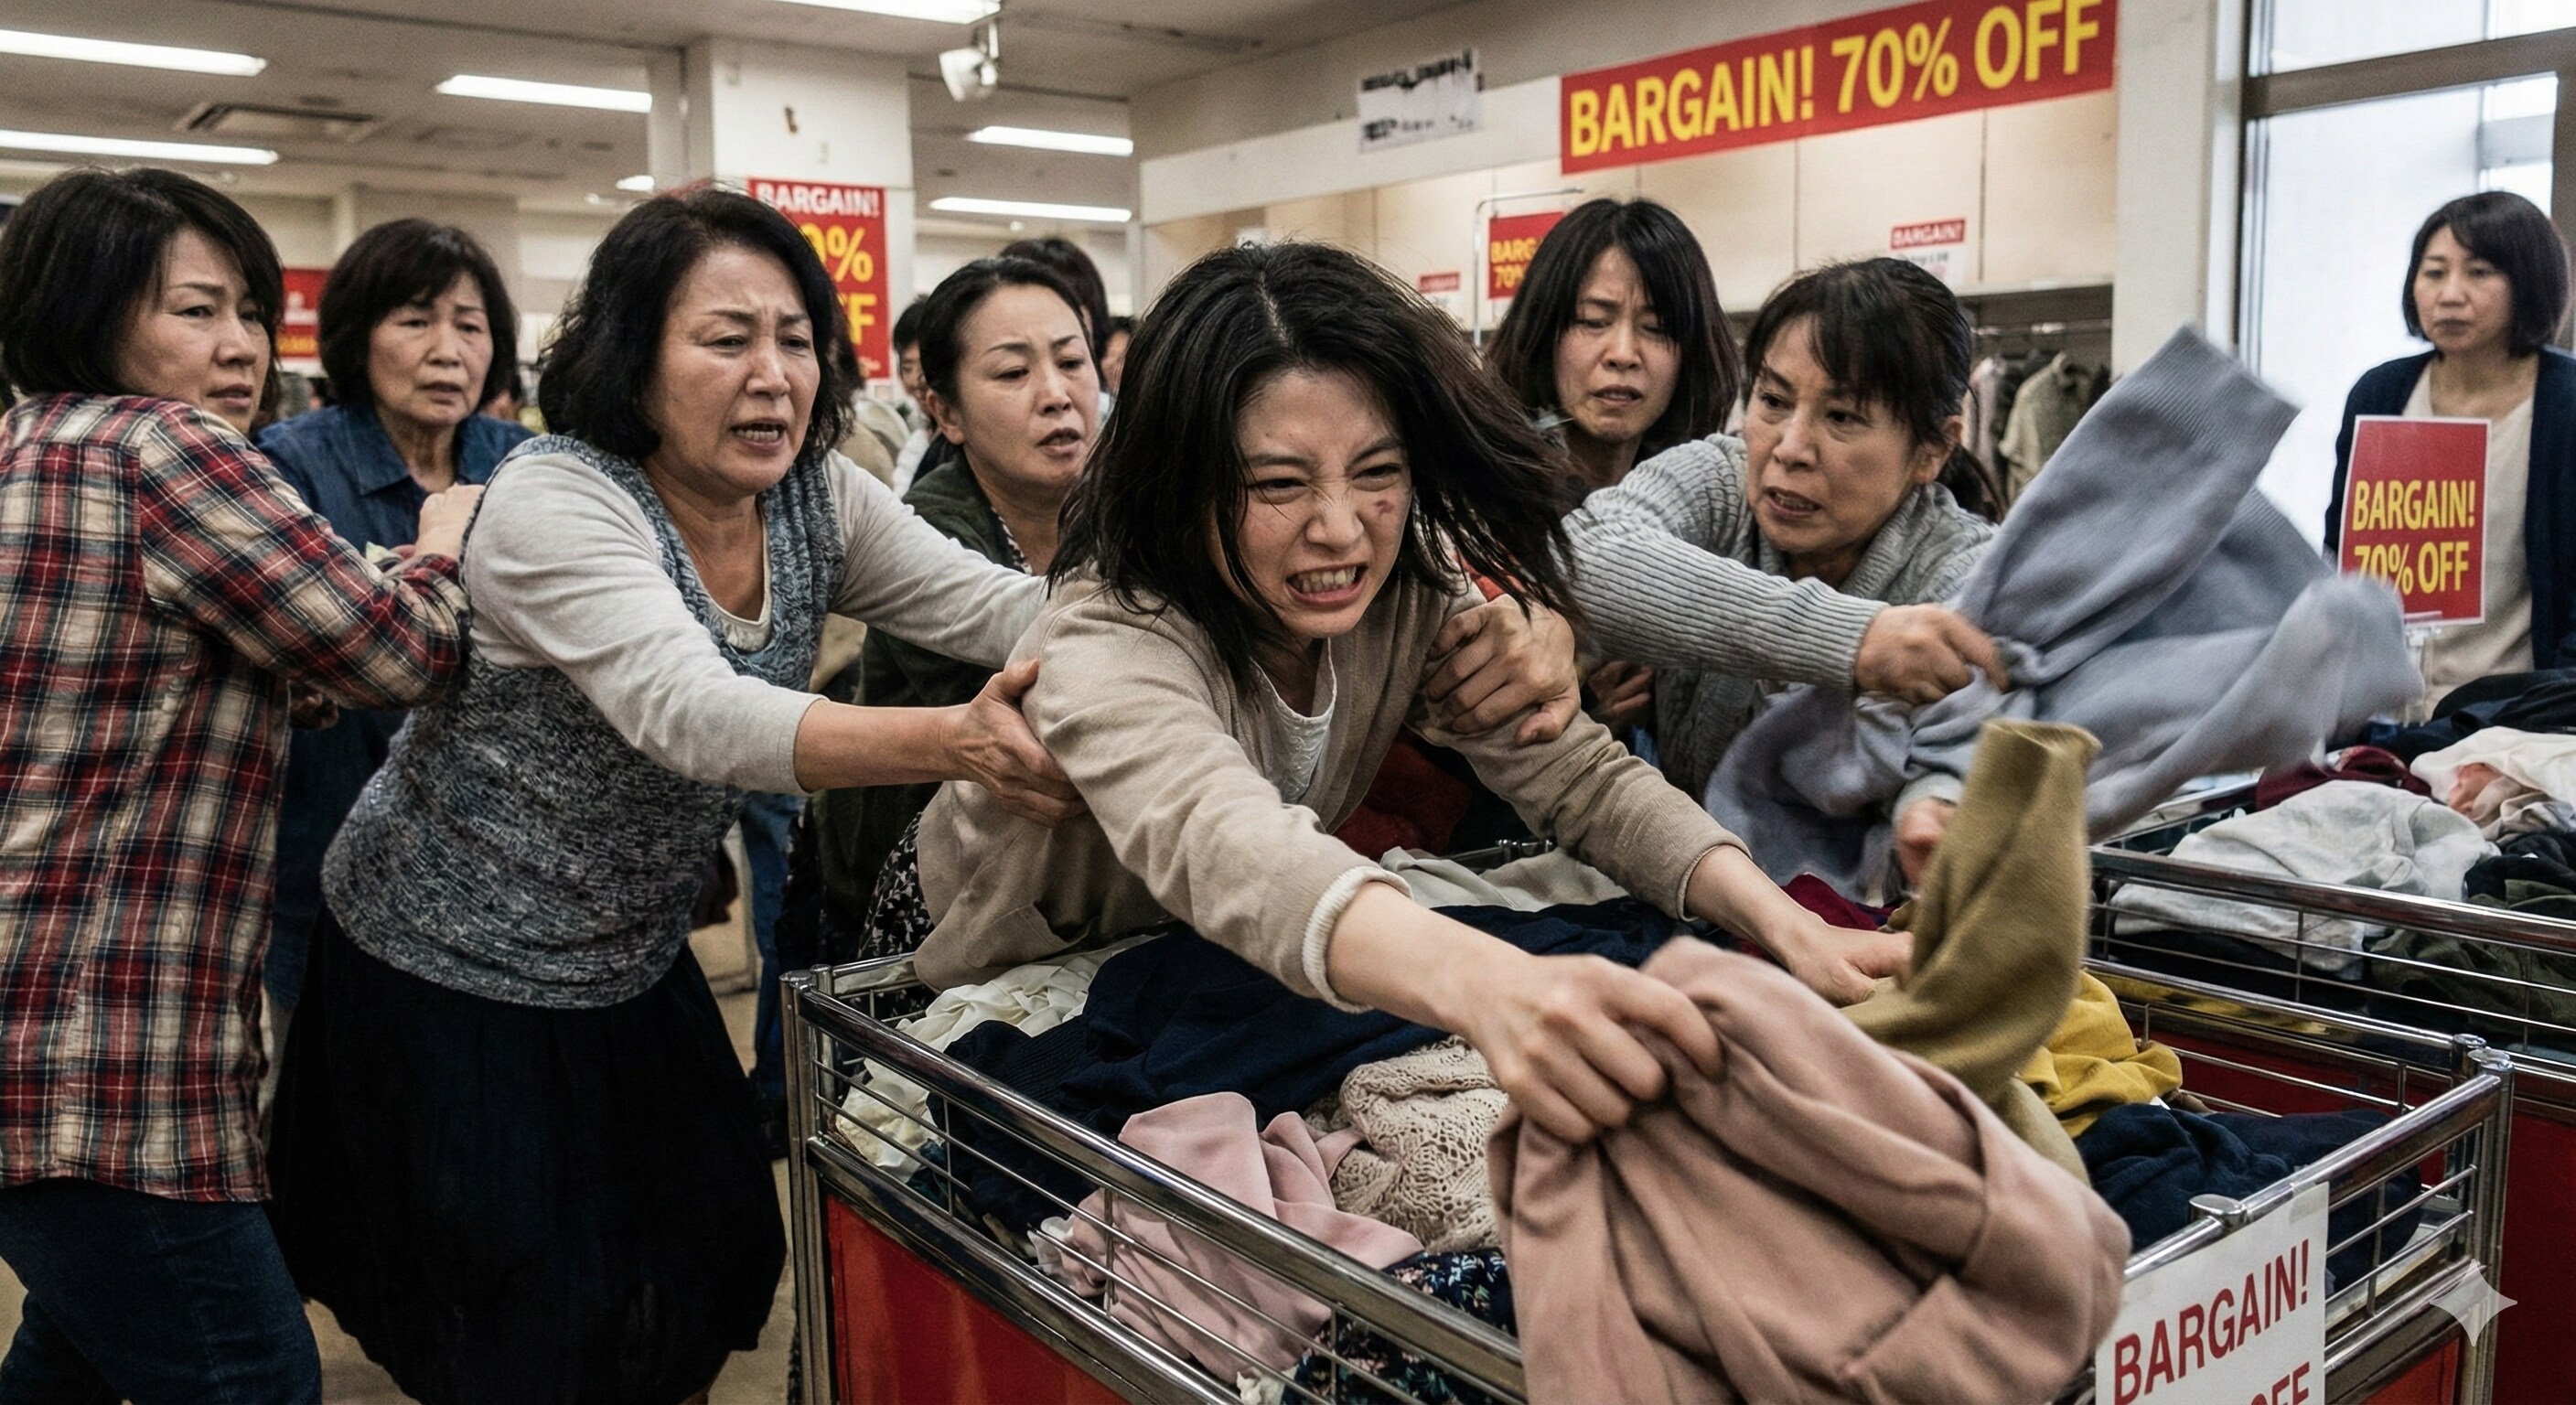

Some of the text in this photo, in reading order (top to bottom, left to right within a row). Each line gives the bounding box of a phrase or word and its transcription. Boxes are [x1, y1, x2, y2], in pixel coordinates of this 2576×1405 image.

[1571, 45, 1814, 157] BARGAIN!
[1831, 16, 1959, 113] 70%
[1973, 0, 2102, 89] OFF
[2352, 479, 2475, 531] BARGAIN!
[2354, 542, 2469, 595] 70% OFF
[2114, 1239, 2309, 1405] BARGAIN!
